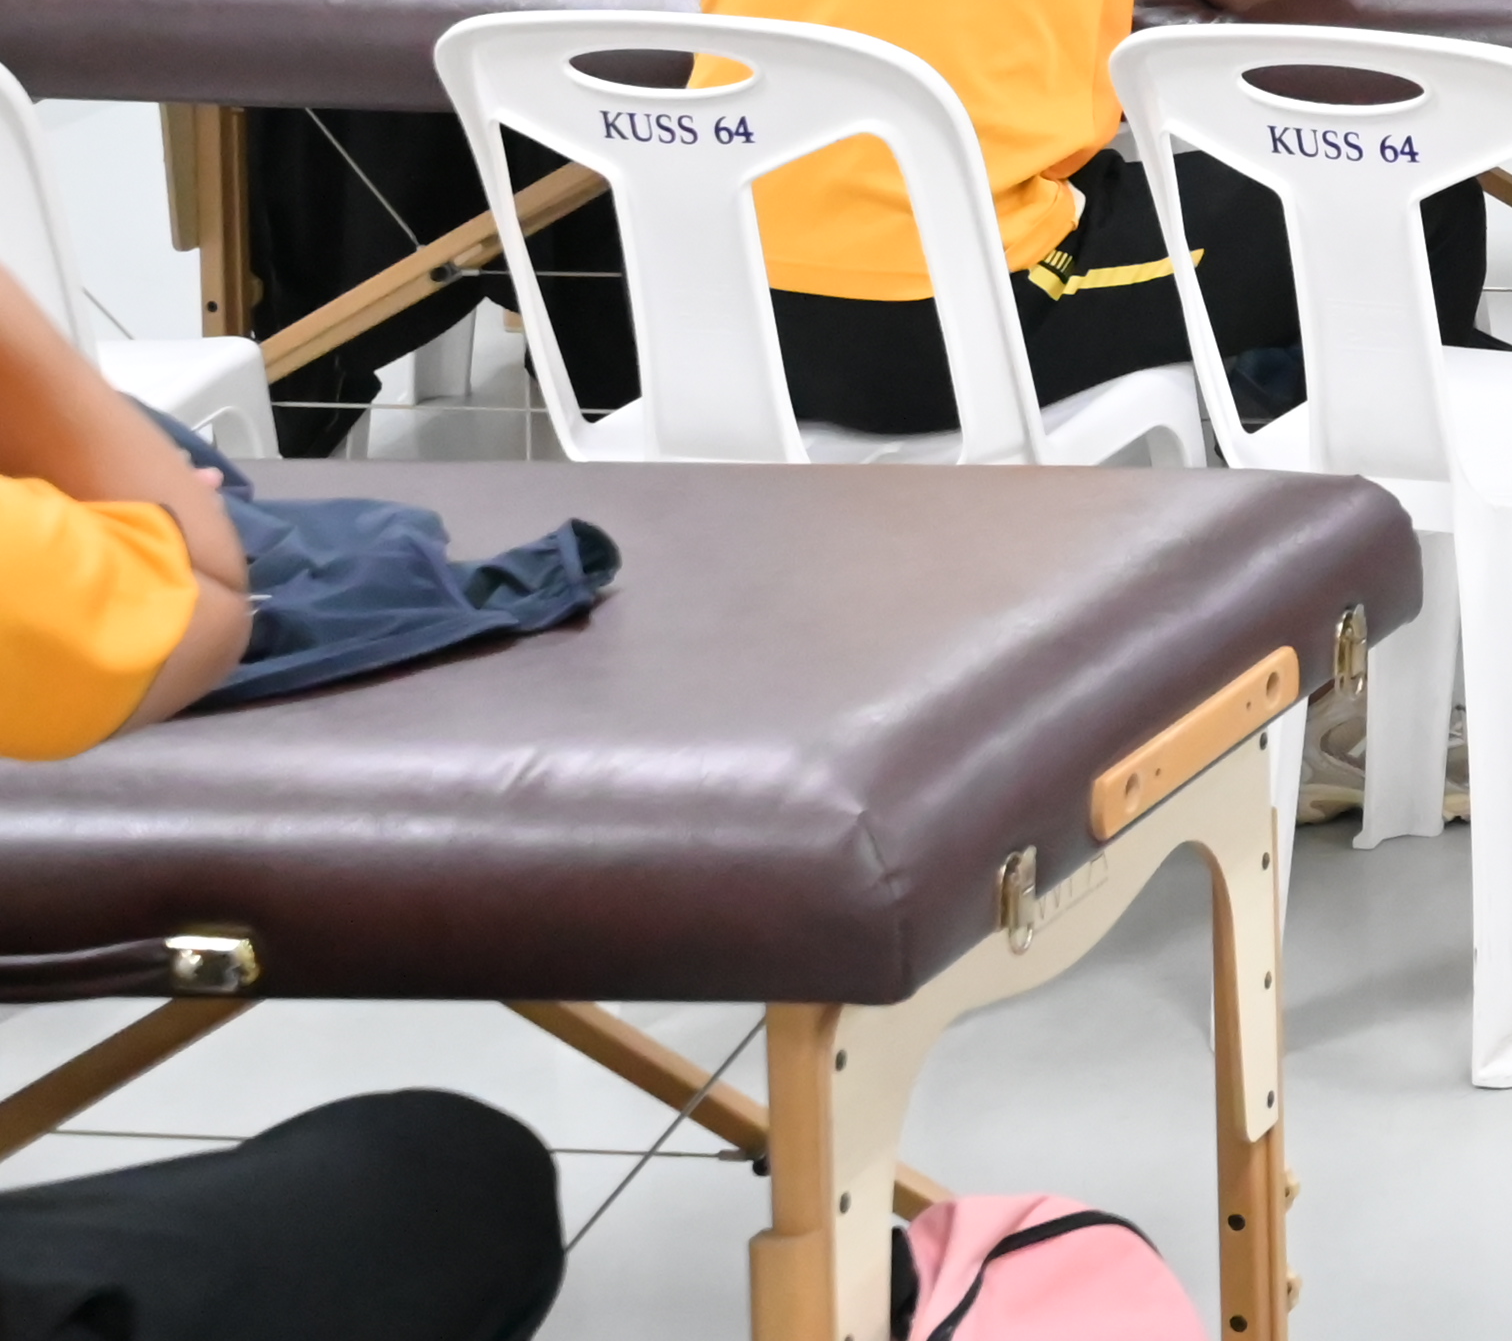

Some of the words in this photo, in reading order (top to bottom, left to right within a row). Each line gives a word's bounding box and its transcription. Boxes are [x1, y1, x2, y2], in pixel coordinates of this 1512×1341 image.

[599, 109, 698, 146] KUSS
[714, 115, 756, 145] 64
[1266, 125, 1364, 162] KUSS
[1379, 134, 1420, 163] 64
